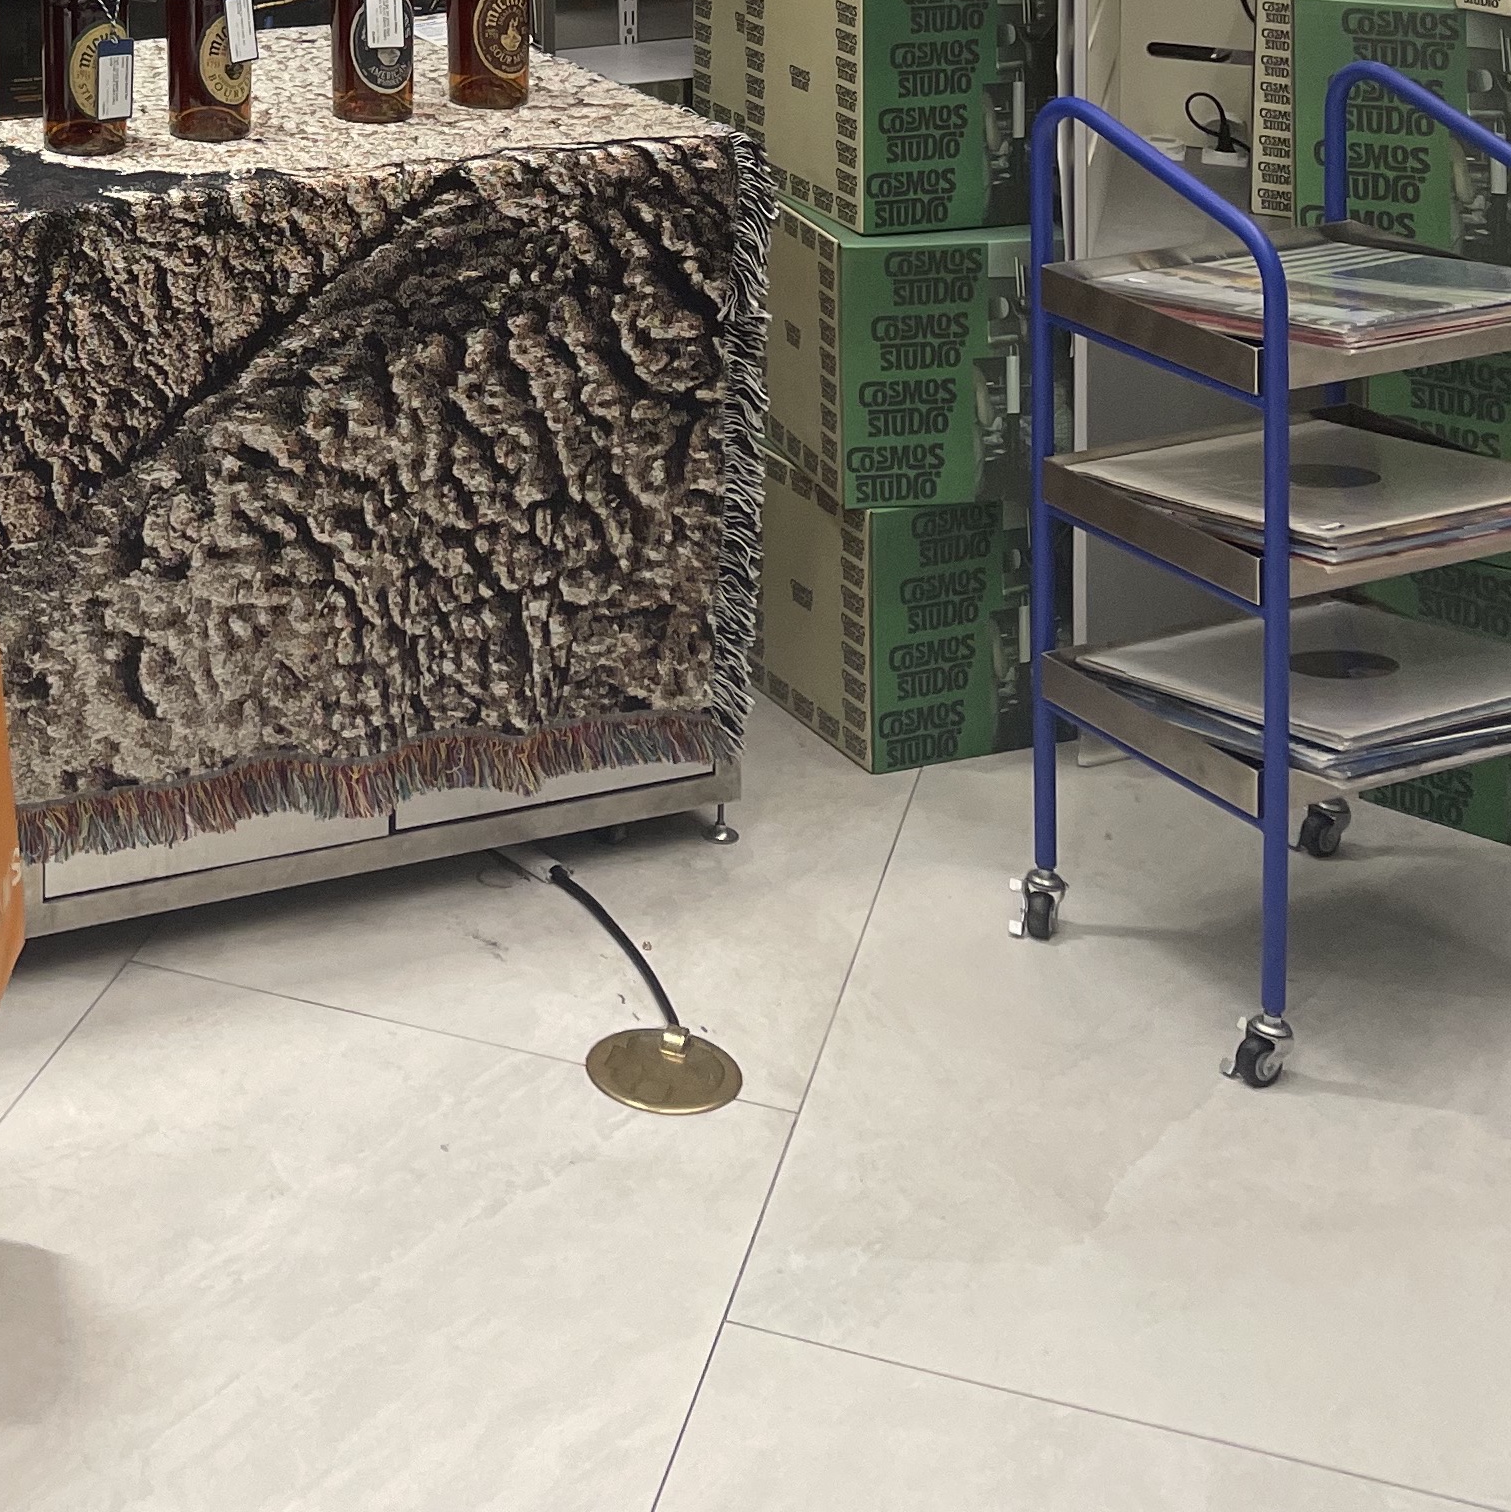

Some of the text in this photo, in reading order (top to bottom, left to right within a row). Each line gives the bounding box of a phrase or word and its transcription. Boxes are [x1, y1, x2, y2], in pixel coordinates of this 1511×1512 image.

[1341, 7, 1460, 41] COSMOS
[877, 103, 968, 135] COSMOS
[886, 131, 965, 165] STUDIO
[866, 167, 957, 200] COSMOS
[874, 194, 953, 229] STUDIO
[857, 377, 958, 409] COSMOS
[867, 404, 954, 439] STUDIO
[845, 442, 946, 475] COSMOS
[855, 471, 942, 505] STUDIO
[879, 699, 966, 739] COSMOS
[886, 727, 963, 769] STUDIO
